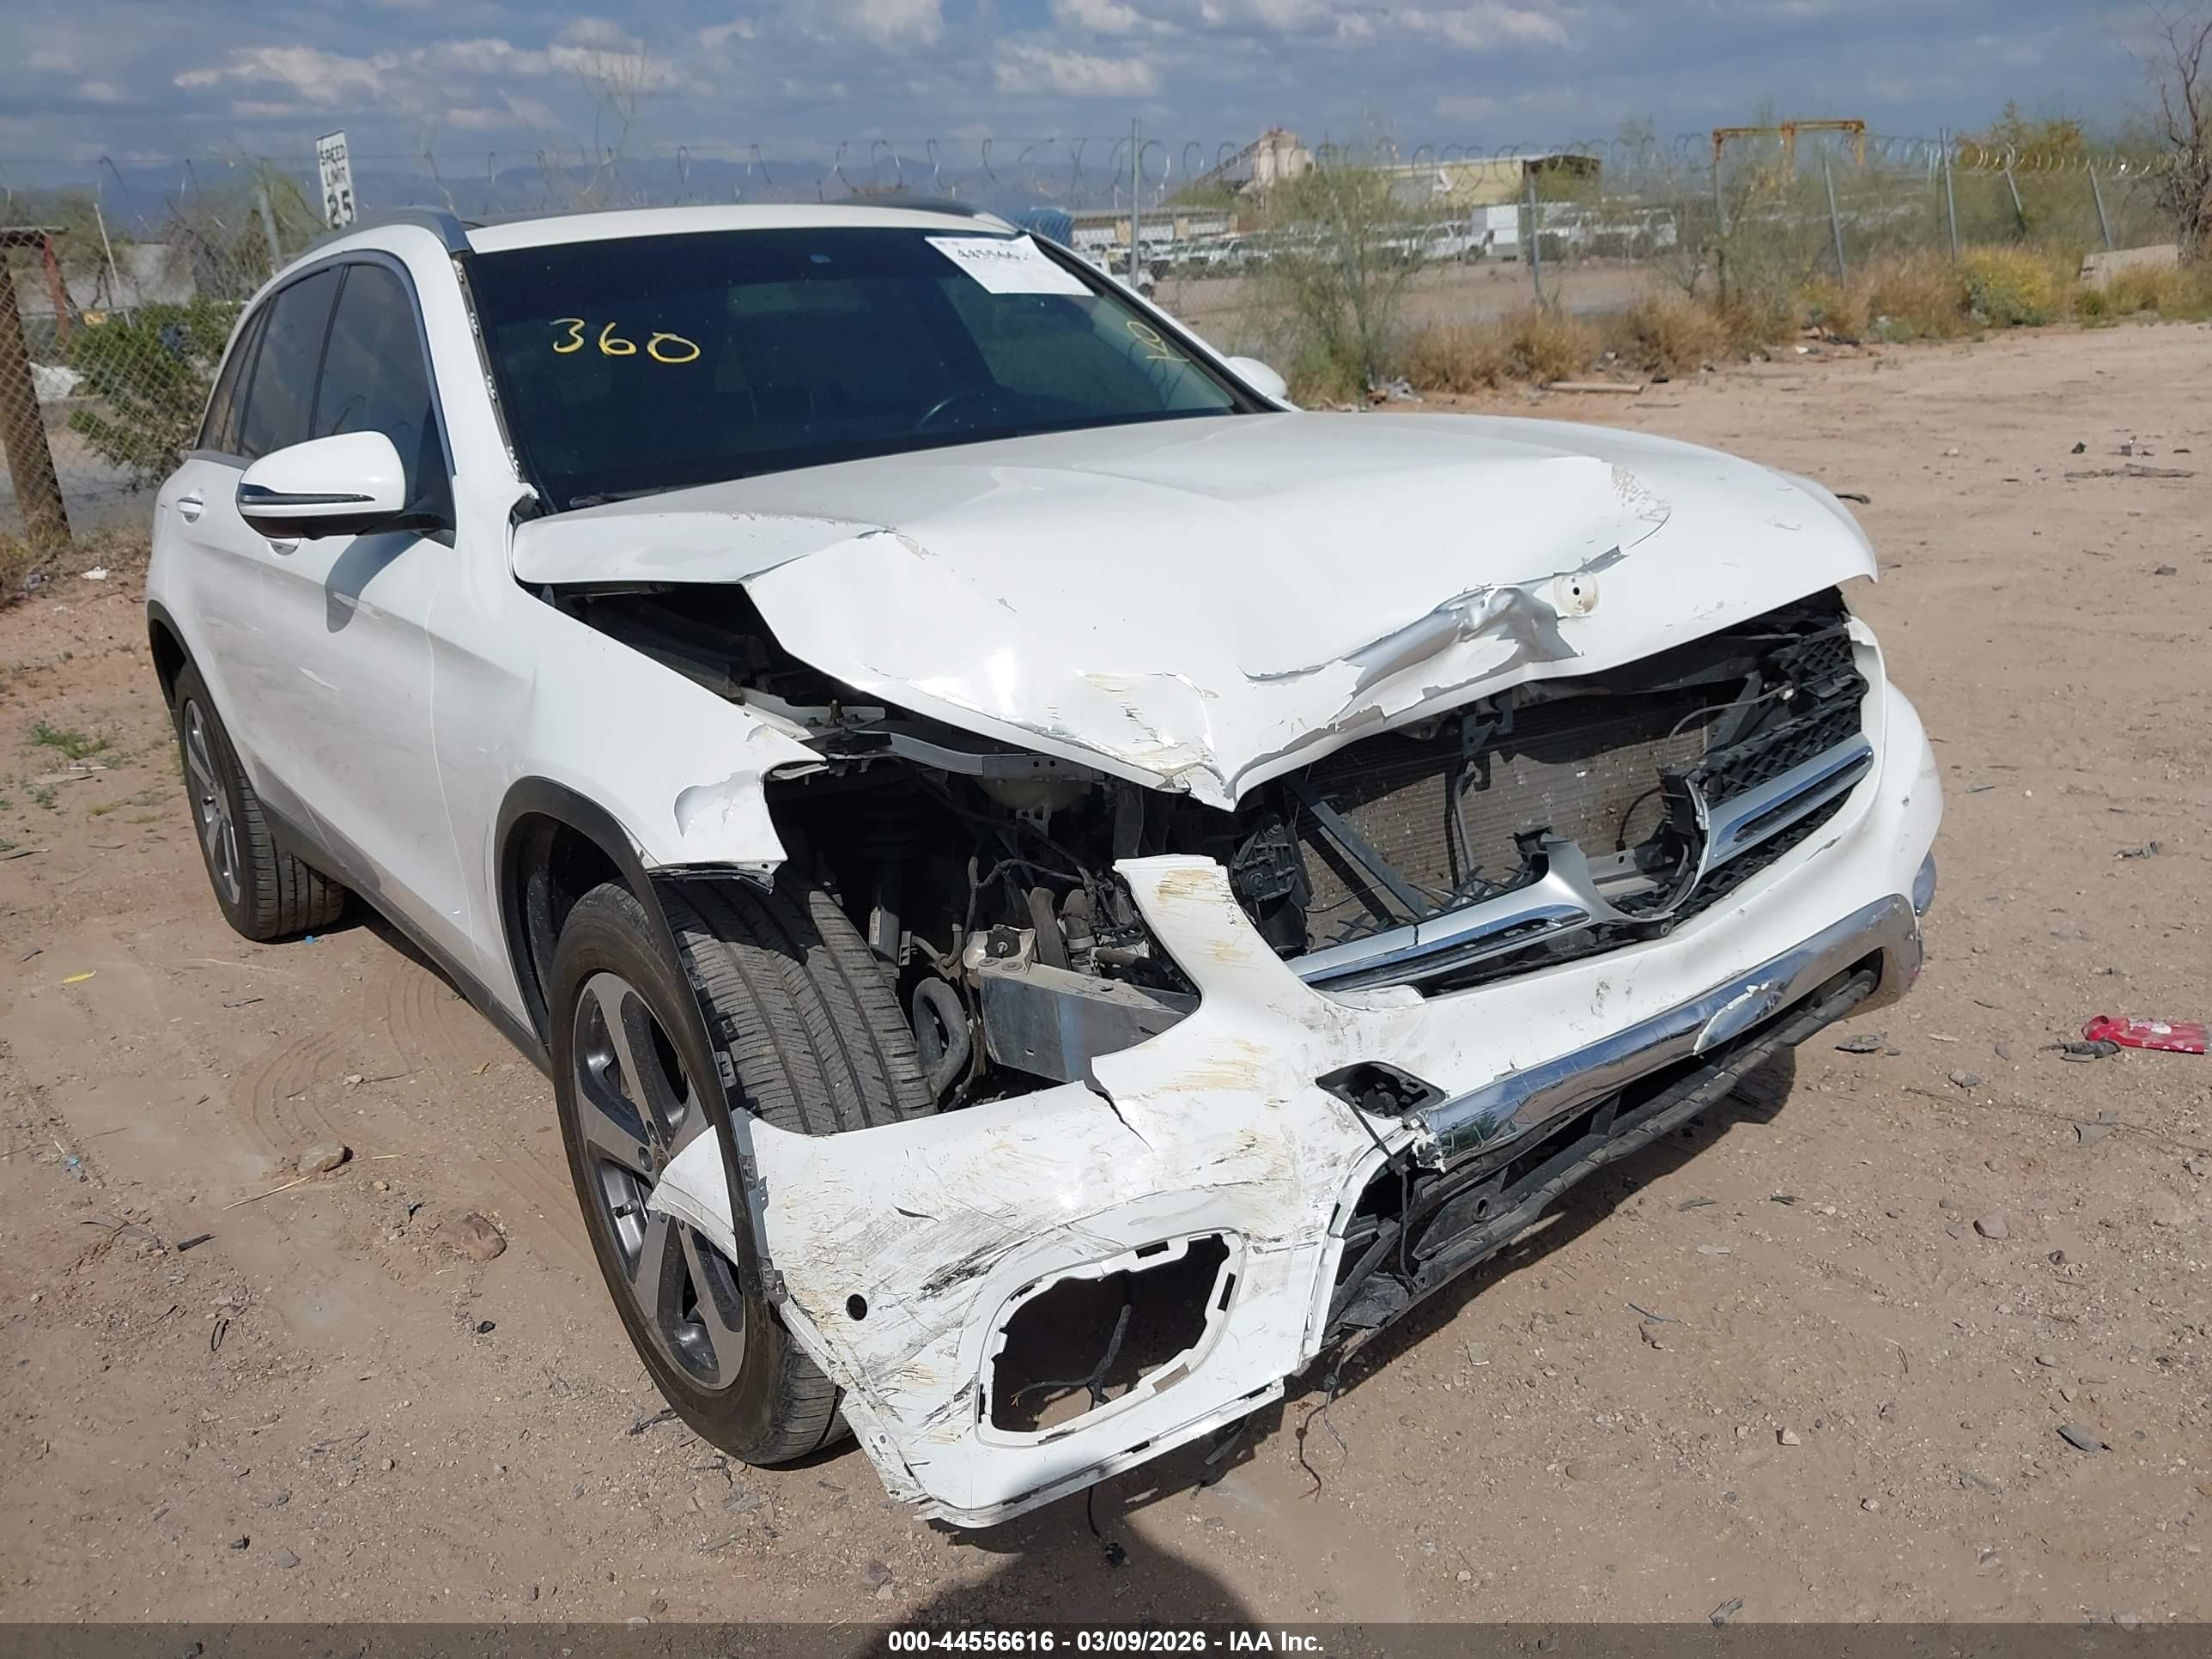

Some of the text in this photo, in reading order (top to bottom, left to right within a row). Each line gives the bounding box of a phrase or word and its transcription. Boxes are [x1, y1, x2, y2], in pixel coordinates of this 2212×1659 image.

[319, 144, 345, 166] SPEED
[327, 190, 354, 230] 25
[550, 318, 701, 362] 360
